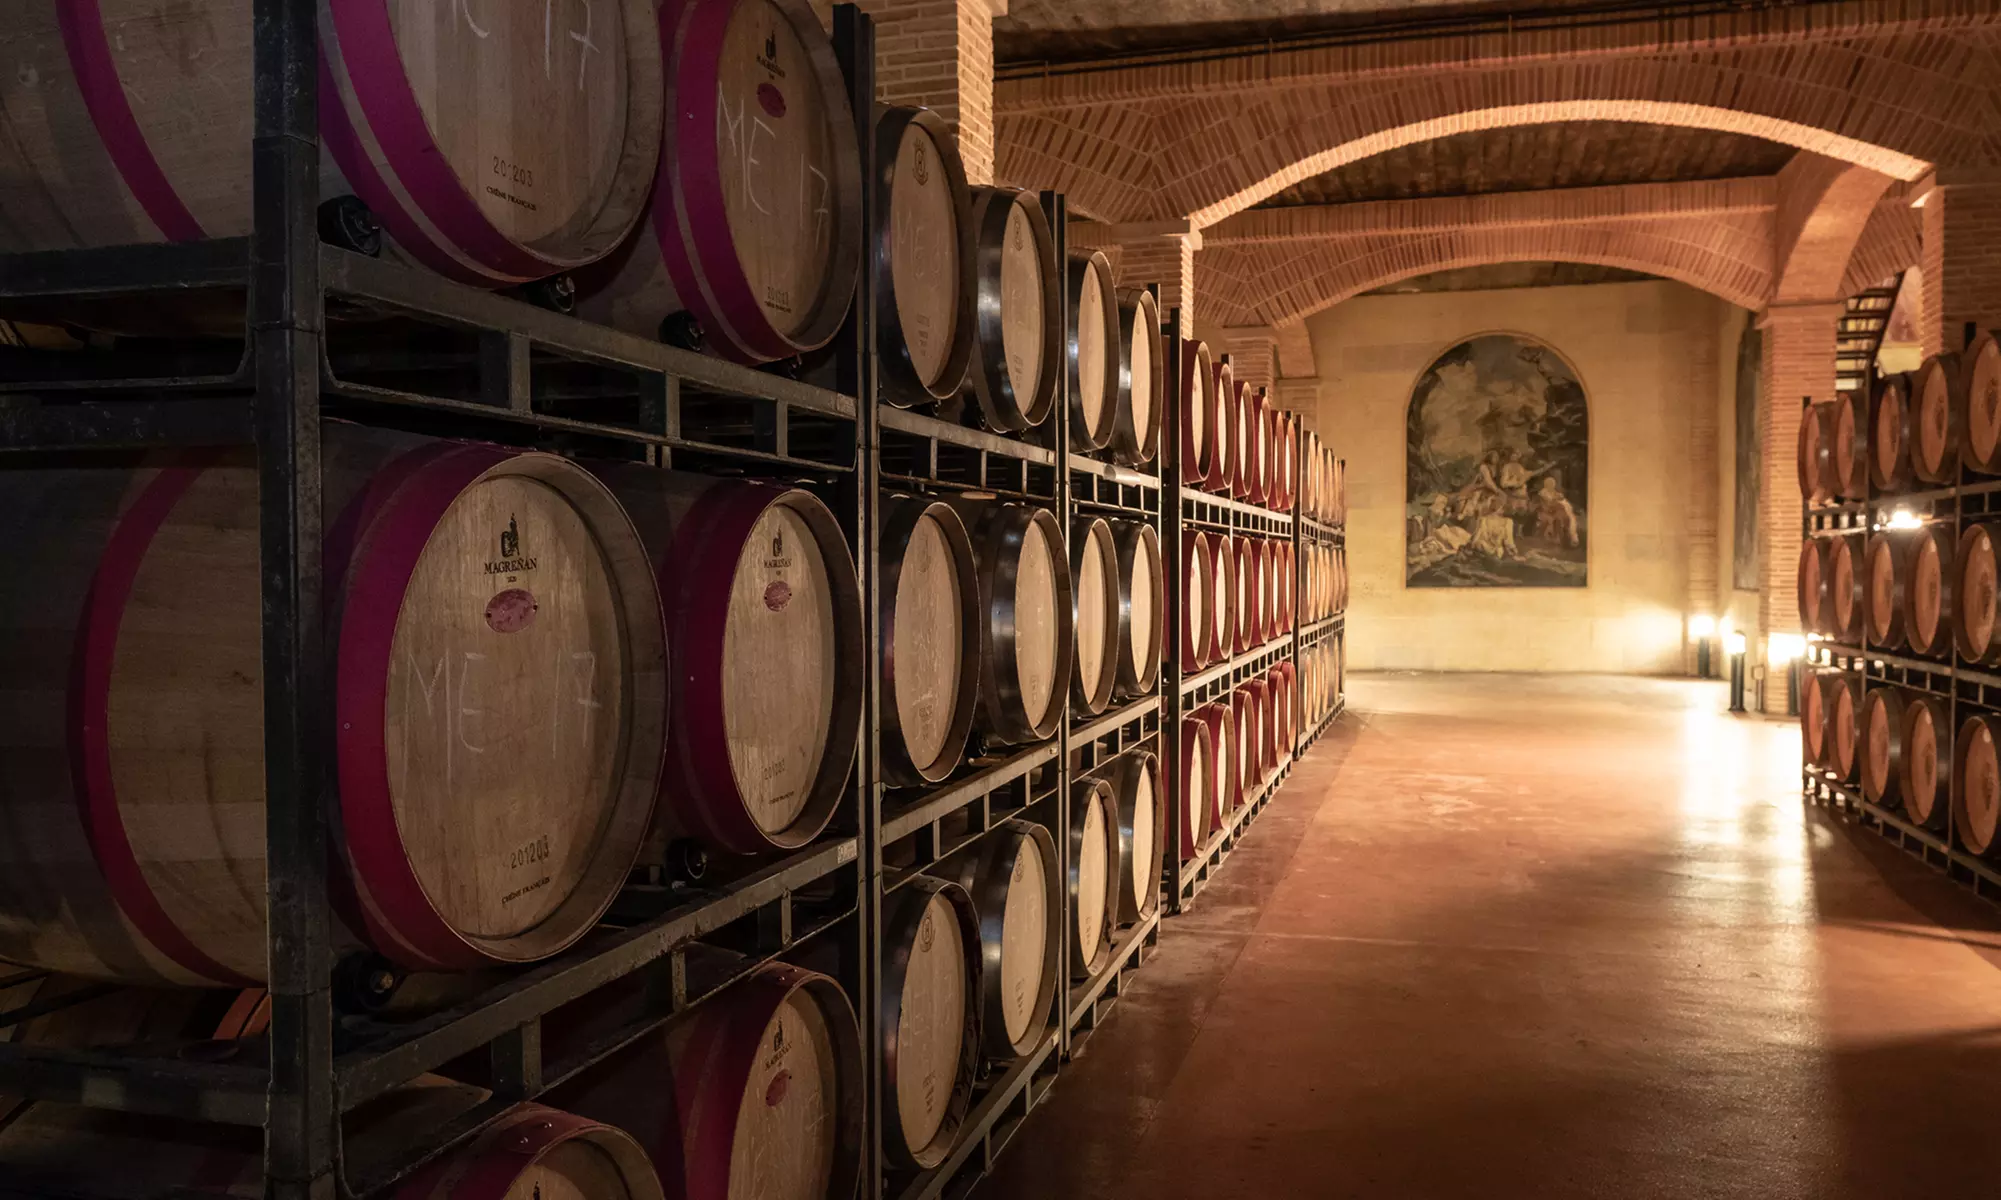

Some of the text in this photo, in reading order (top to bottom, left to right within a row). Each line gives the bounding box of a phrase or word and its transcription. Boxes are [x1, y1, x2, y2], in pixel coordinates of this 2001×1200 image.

[716, 80, 777, 216] ME
[798, 152, 829, 252] 17
[484, 557, 537, 575] MAGREÑAN
[401, 647, 602, 802] ME 17
[510, 834, 550, 869] 201203
